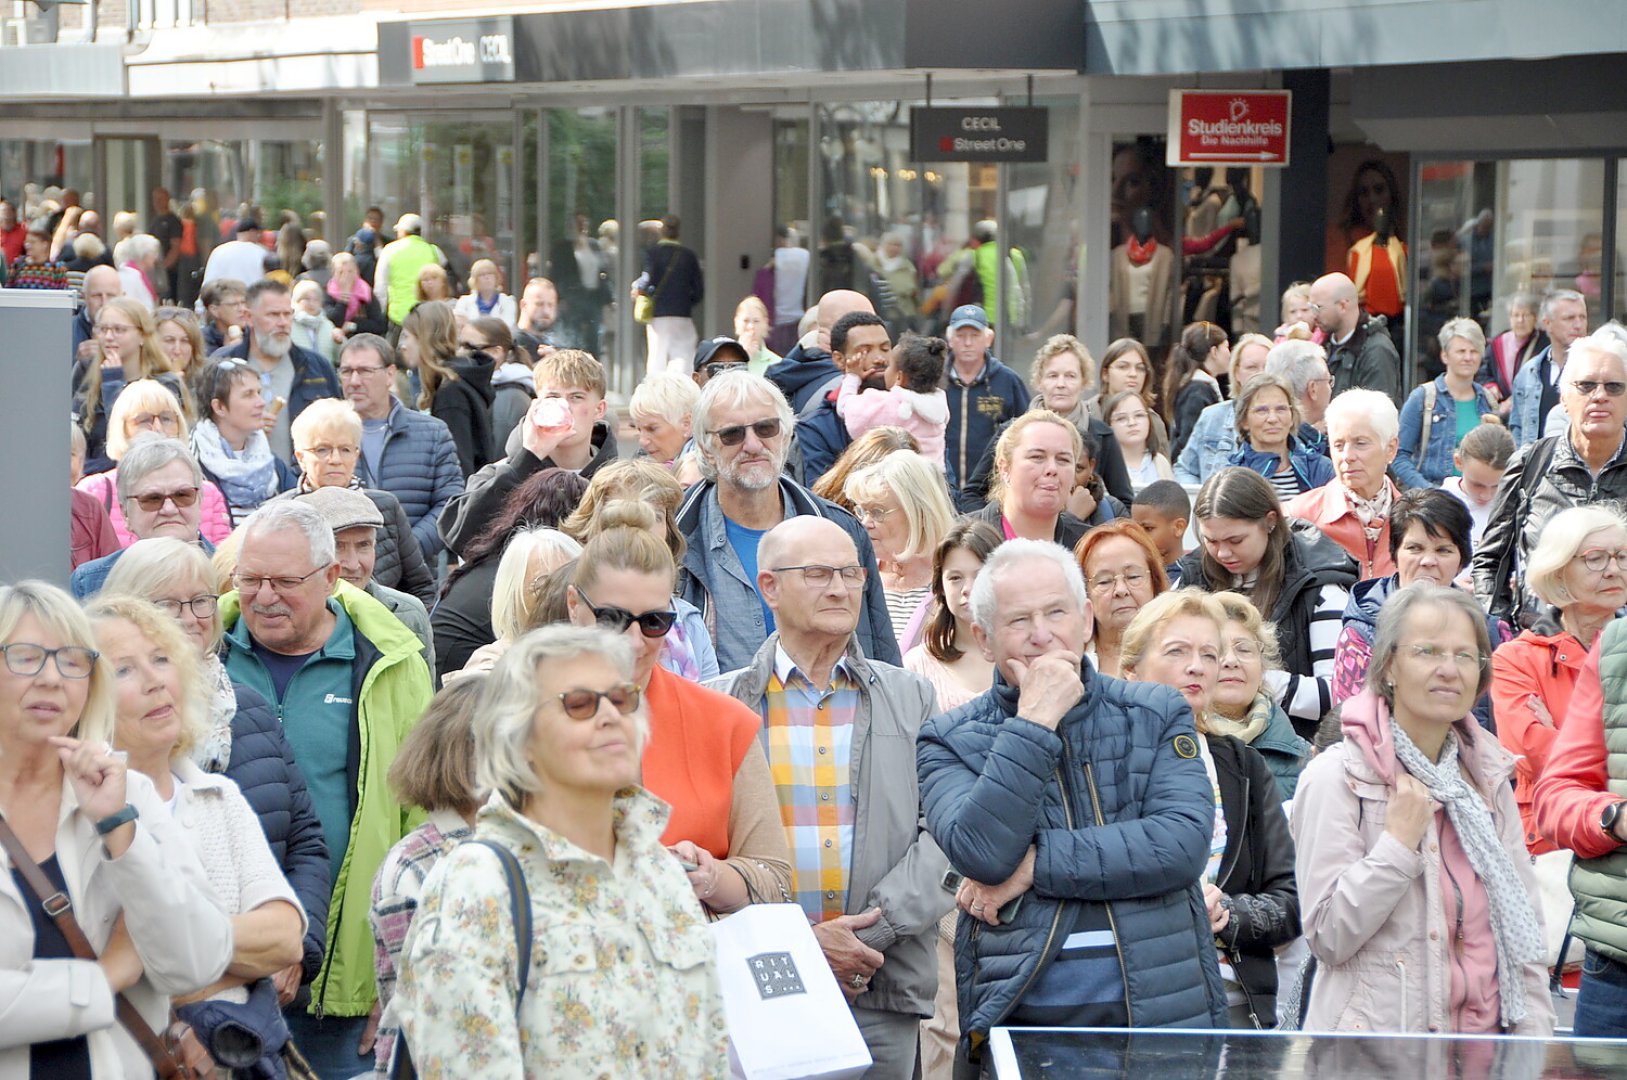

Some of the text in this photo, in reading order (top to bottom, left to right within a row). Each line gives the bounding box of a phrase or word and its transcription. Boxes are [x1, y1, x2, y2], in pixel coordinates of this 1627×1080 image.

[962, 117, 1001, 131] CECIL
[1188, 118, 1282, 136] Studienkreis
[1201, 135, 1269, 146] Die Nachhilfe
